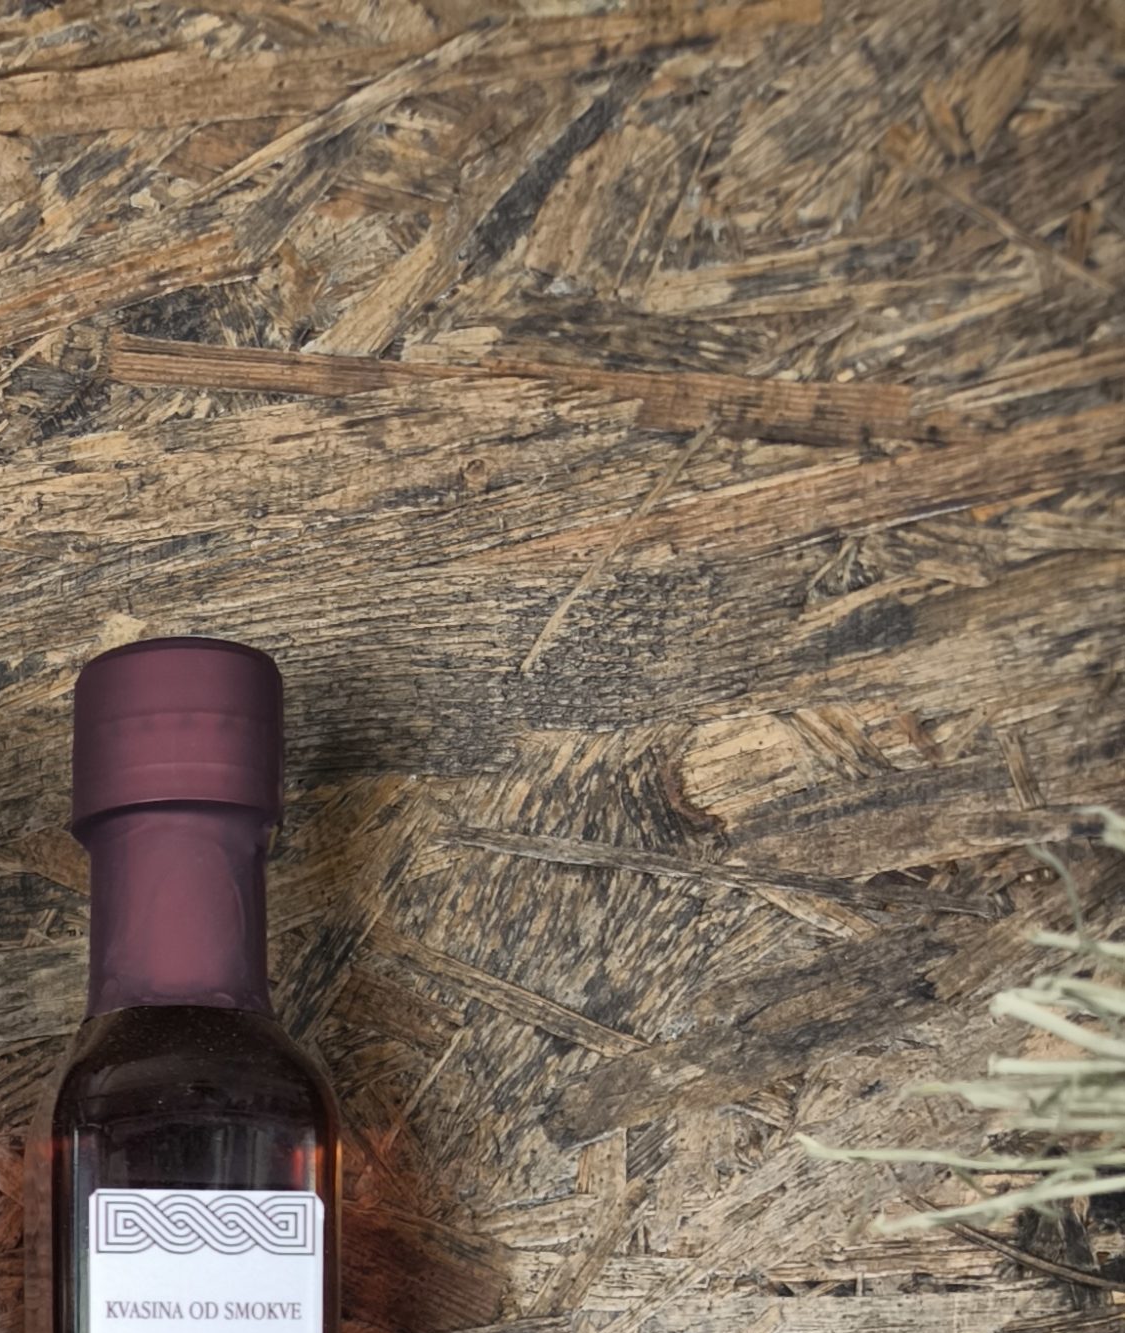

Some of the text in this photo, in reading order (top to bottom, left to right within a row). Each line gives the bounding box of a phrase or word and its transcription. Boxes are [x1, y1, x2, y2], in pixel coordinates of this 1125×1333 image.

[105, 1301, 302, 1321] KVASINA OD SMOKVE
